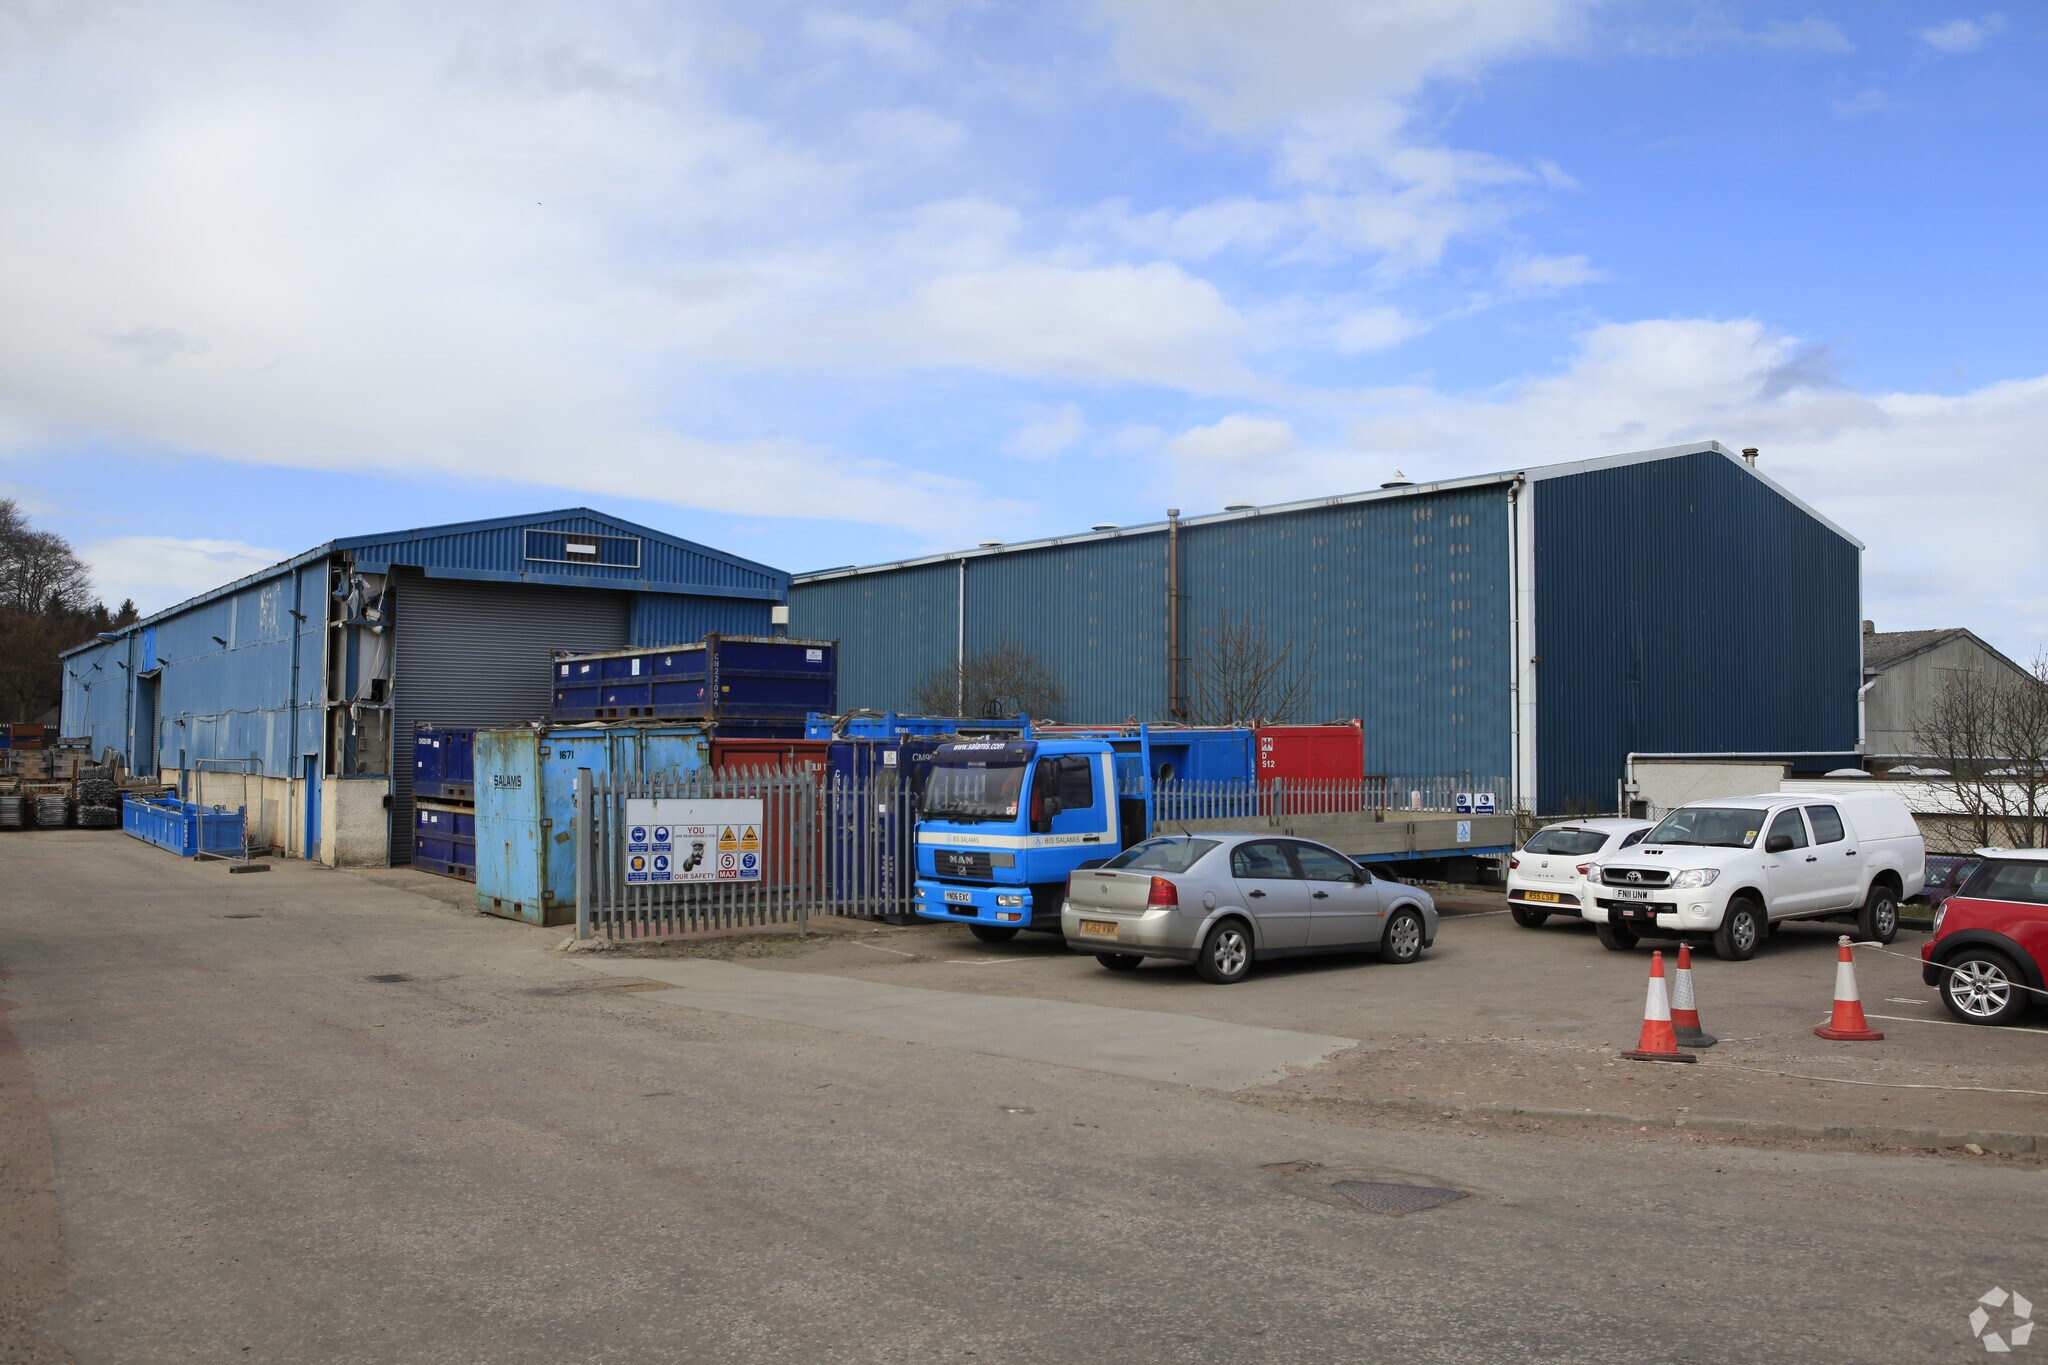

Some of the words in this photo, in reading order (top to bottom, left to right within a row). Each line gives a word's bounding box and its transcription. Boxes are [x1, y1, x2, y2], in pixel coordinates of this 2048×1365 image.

[953, 742, 1005, 750] www.salamis.com
[559, 750, 574, 759] 1671
[494, 775, 522, 787] SALAMIS
[725, 857, 731, 866] 5
[949, 855, 974, 864] MAN
